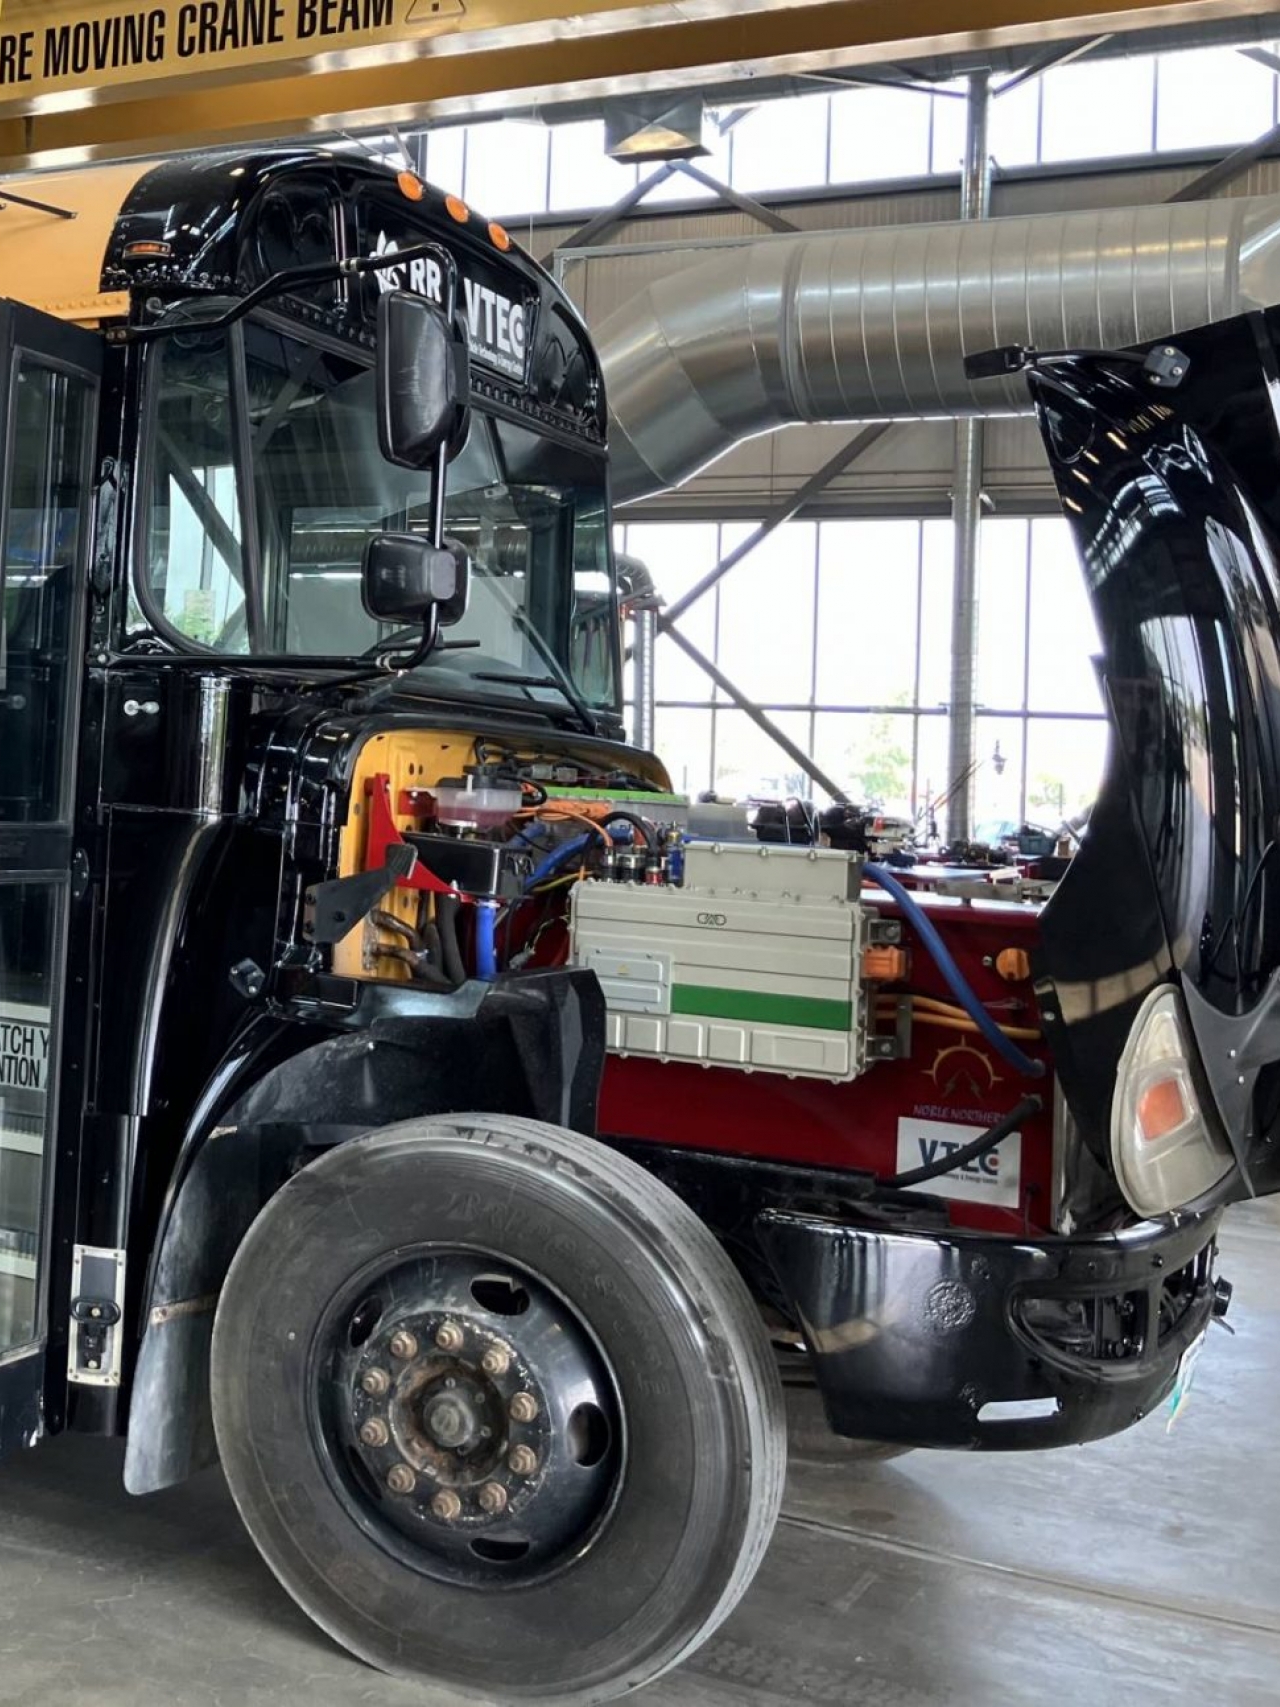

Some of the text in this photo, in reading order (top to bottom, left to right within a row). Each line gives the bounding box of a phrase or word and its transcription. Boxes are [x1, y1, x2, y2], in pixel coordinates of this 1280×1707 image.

[43, 8, 166, 78] MOVING
[177, 0, 285, 57] CRANE
[297, 0, 393, 38] BEAM
[463, 277, 524, 360] VTEC
[913, 1104, 1007, 1123] NOBLE NORTHER
